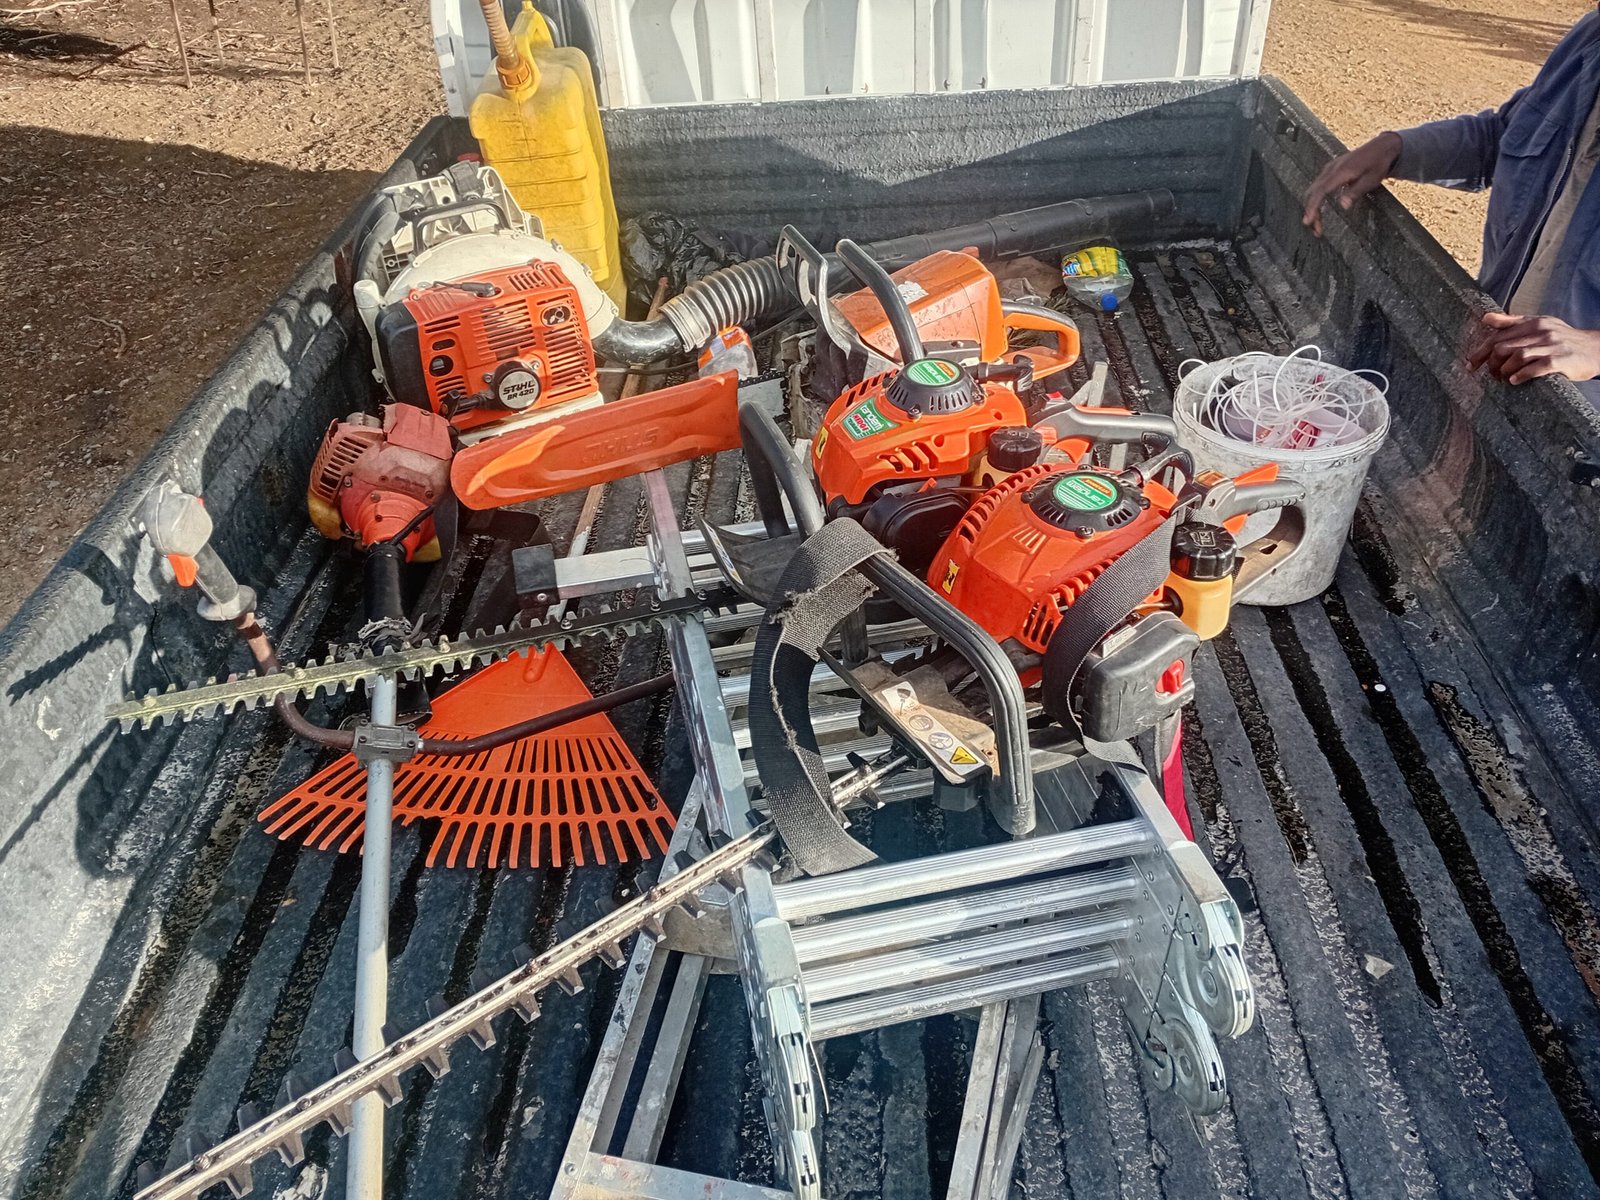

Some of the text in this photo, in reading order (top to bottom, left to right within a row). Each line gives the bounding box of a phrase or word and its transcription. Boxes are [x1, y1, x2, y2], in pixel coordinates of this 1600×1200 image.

[503, 381, 535, 395] STIHL
[507, 388, 534, 401] BR 420
